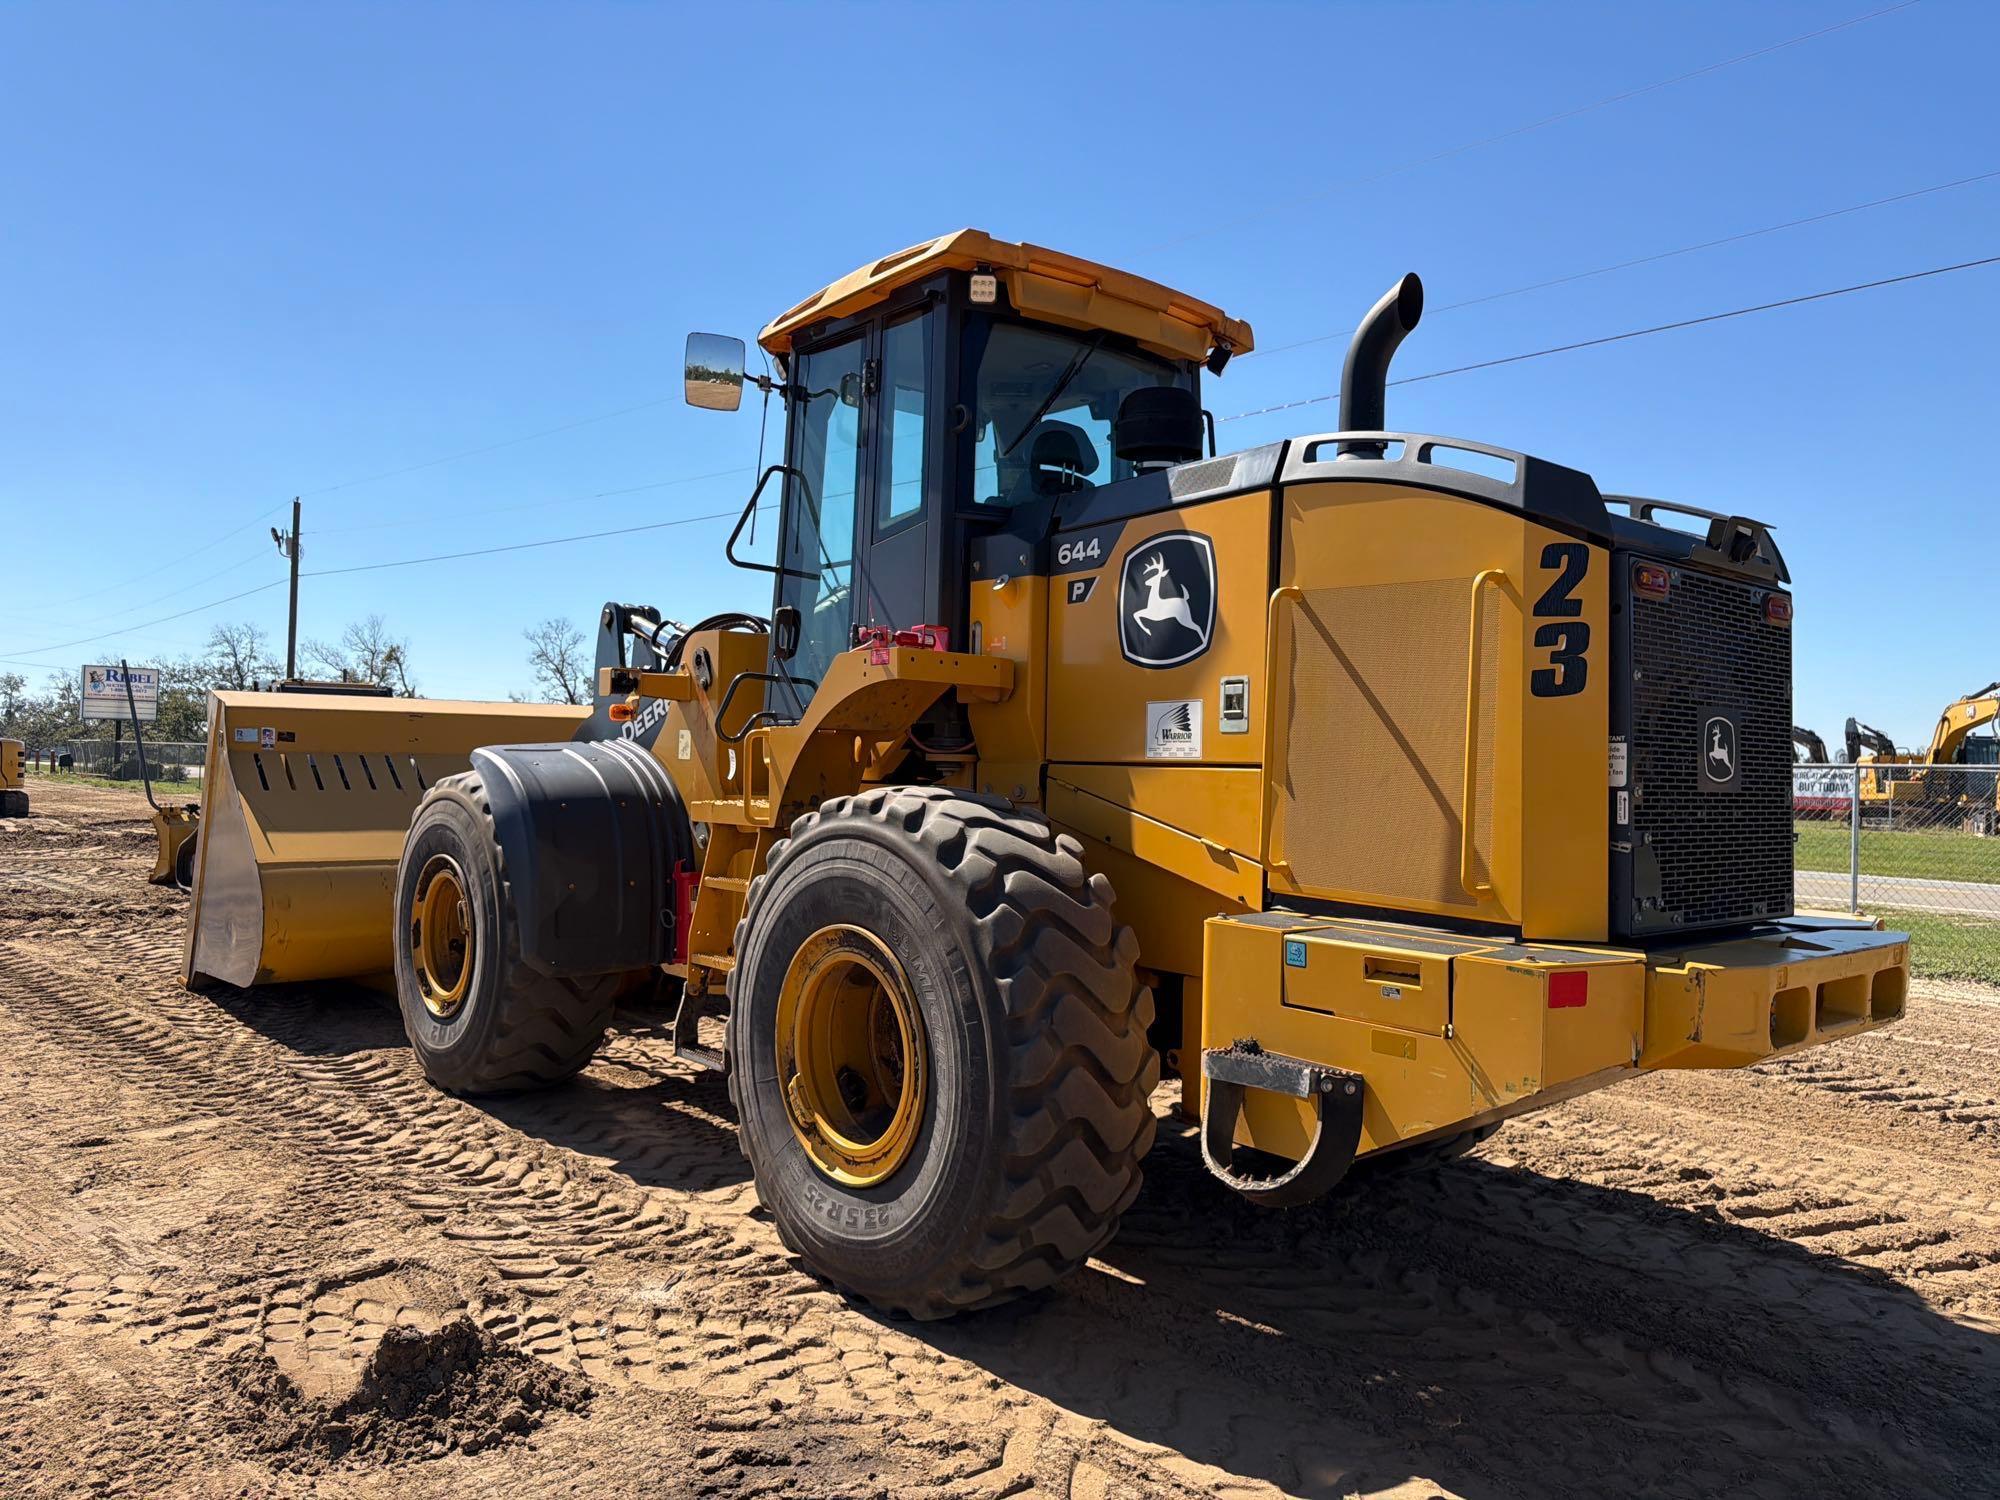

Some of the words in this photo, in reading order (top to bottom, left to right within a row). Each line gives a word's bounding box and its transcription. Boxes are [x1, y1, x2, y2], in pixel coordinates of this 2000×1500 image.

[1058, 538, 1101, 565] 644
[1072, 582, 1085, 601] P
[1162, 729, 1192, 740] WARRIOR
[1799, 782, 1815, 791] BUY
